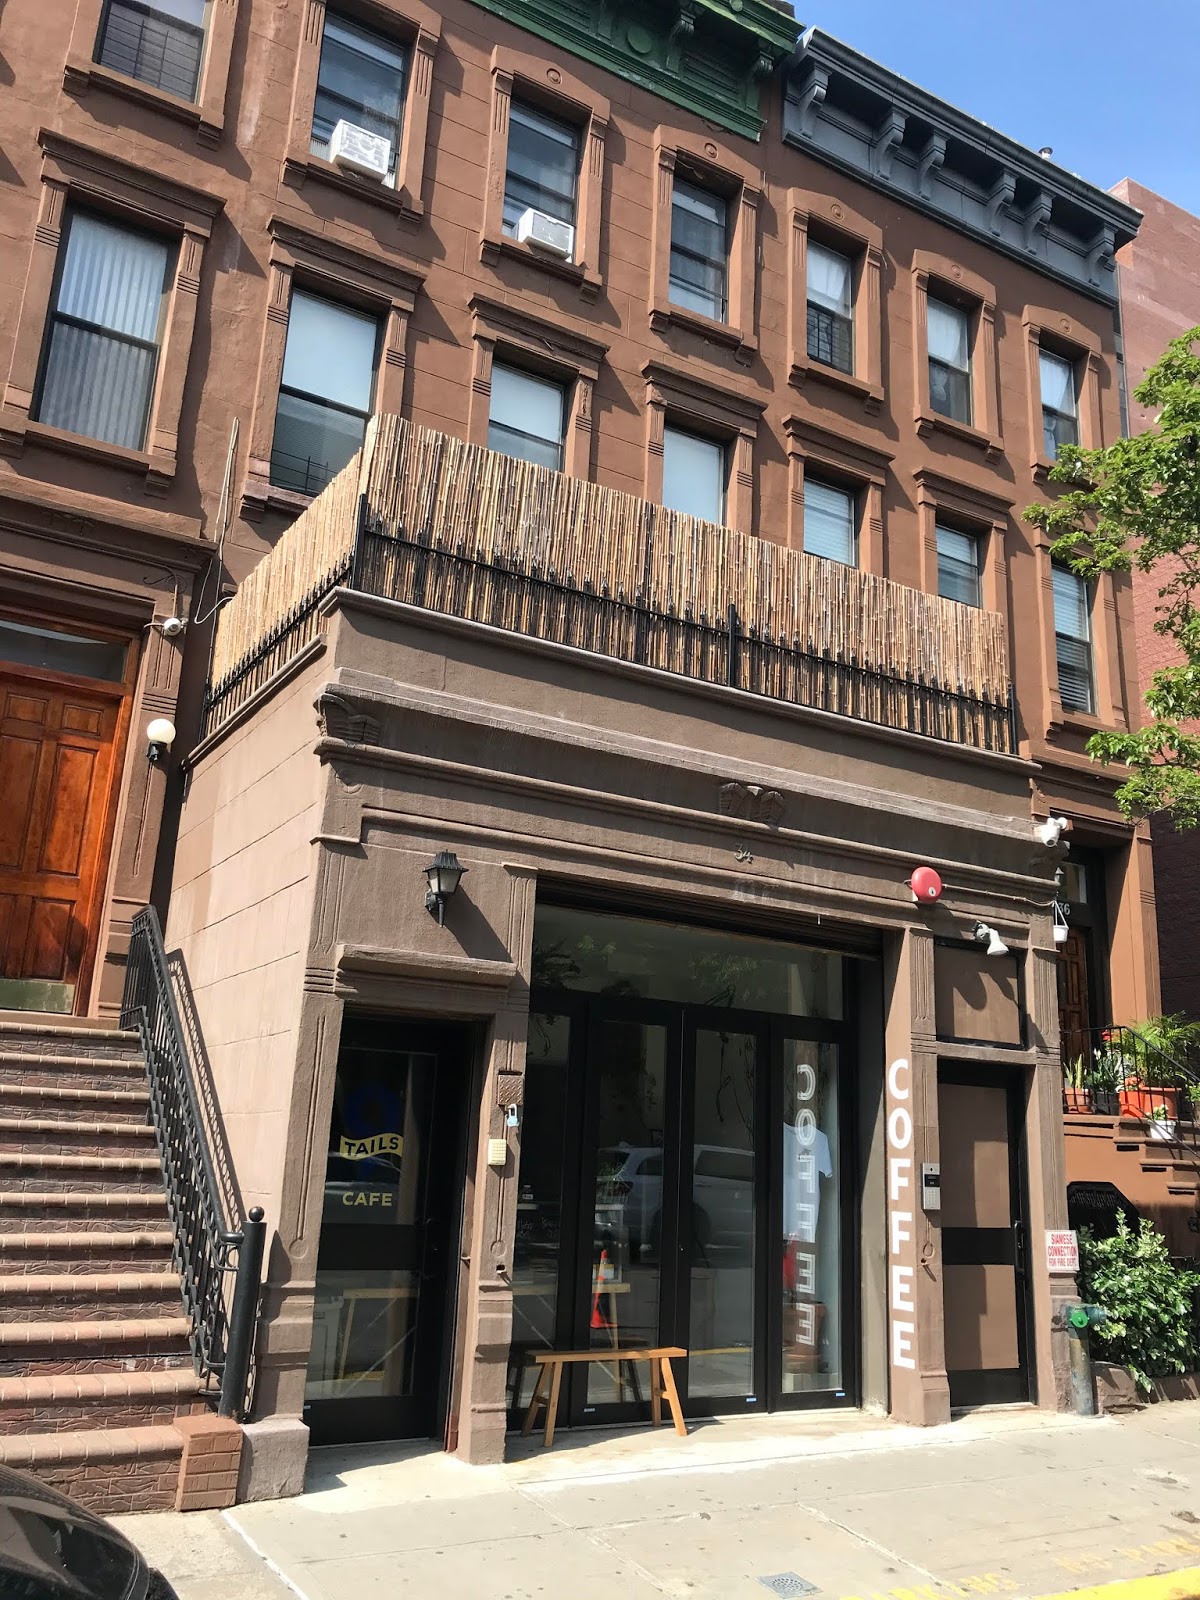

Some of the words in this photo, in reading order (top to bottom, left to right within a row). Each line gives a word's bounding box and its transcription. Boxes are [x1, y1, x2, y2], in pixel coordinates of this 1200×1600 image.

[344, 1136, 399, 1157] TAILS
[342, 1191, 393, 1207] CAFE
[888, 1058, 916, 1369] COFFEE
[1051, 1234, 1073, 1245] SIAMESE
[1048, 1246, 1077, 1257] CONNECTION
[1049, 1258, 1057, 1267] FOR
[1057, 1258, 1065, 1267] FIRE
